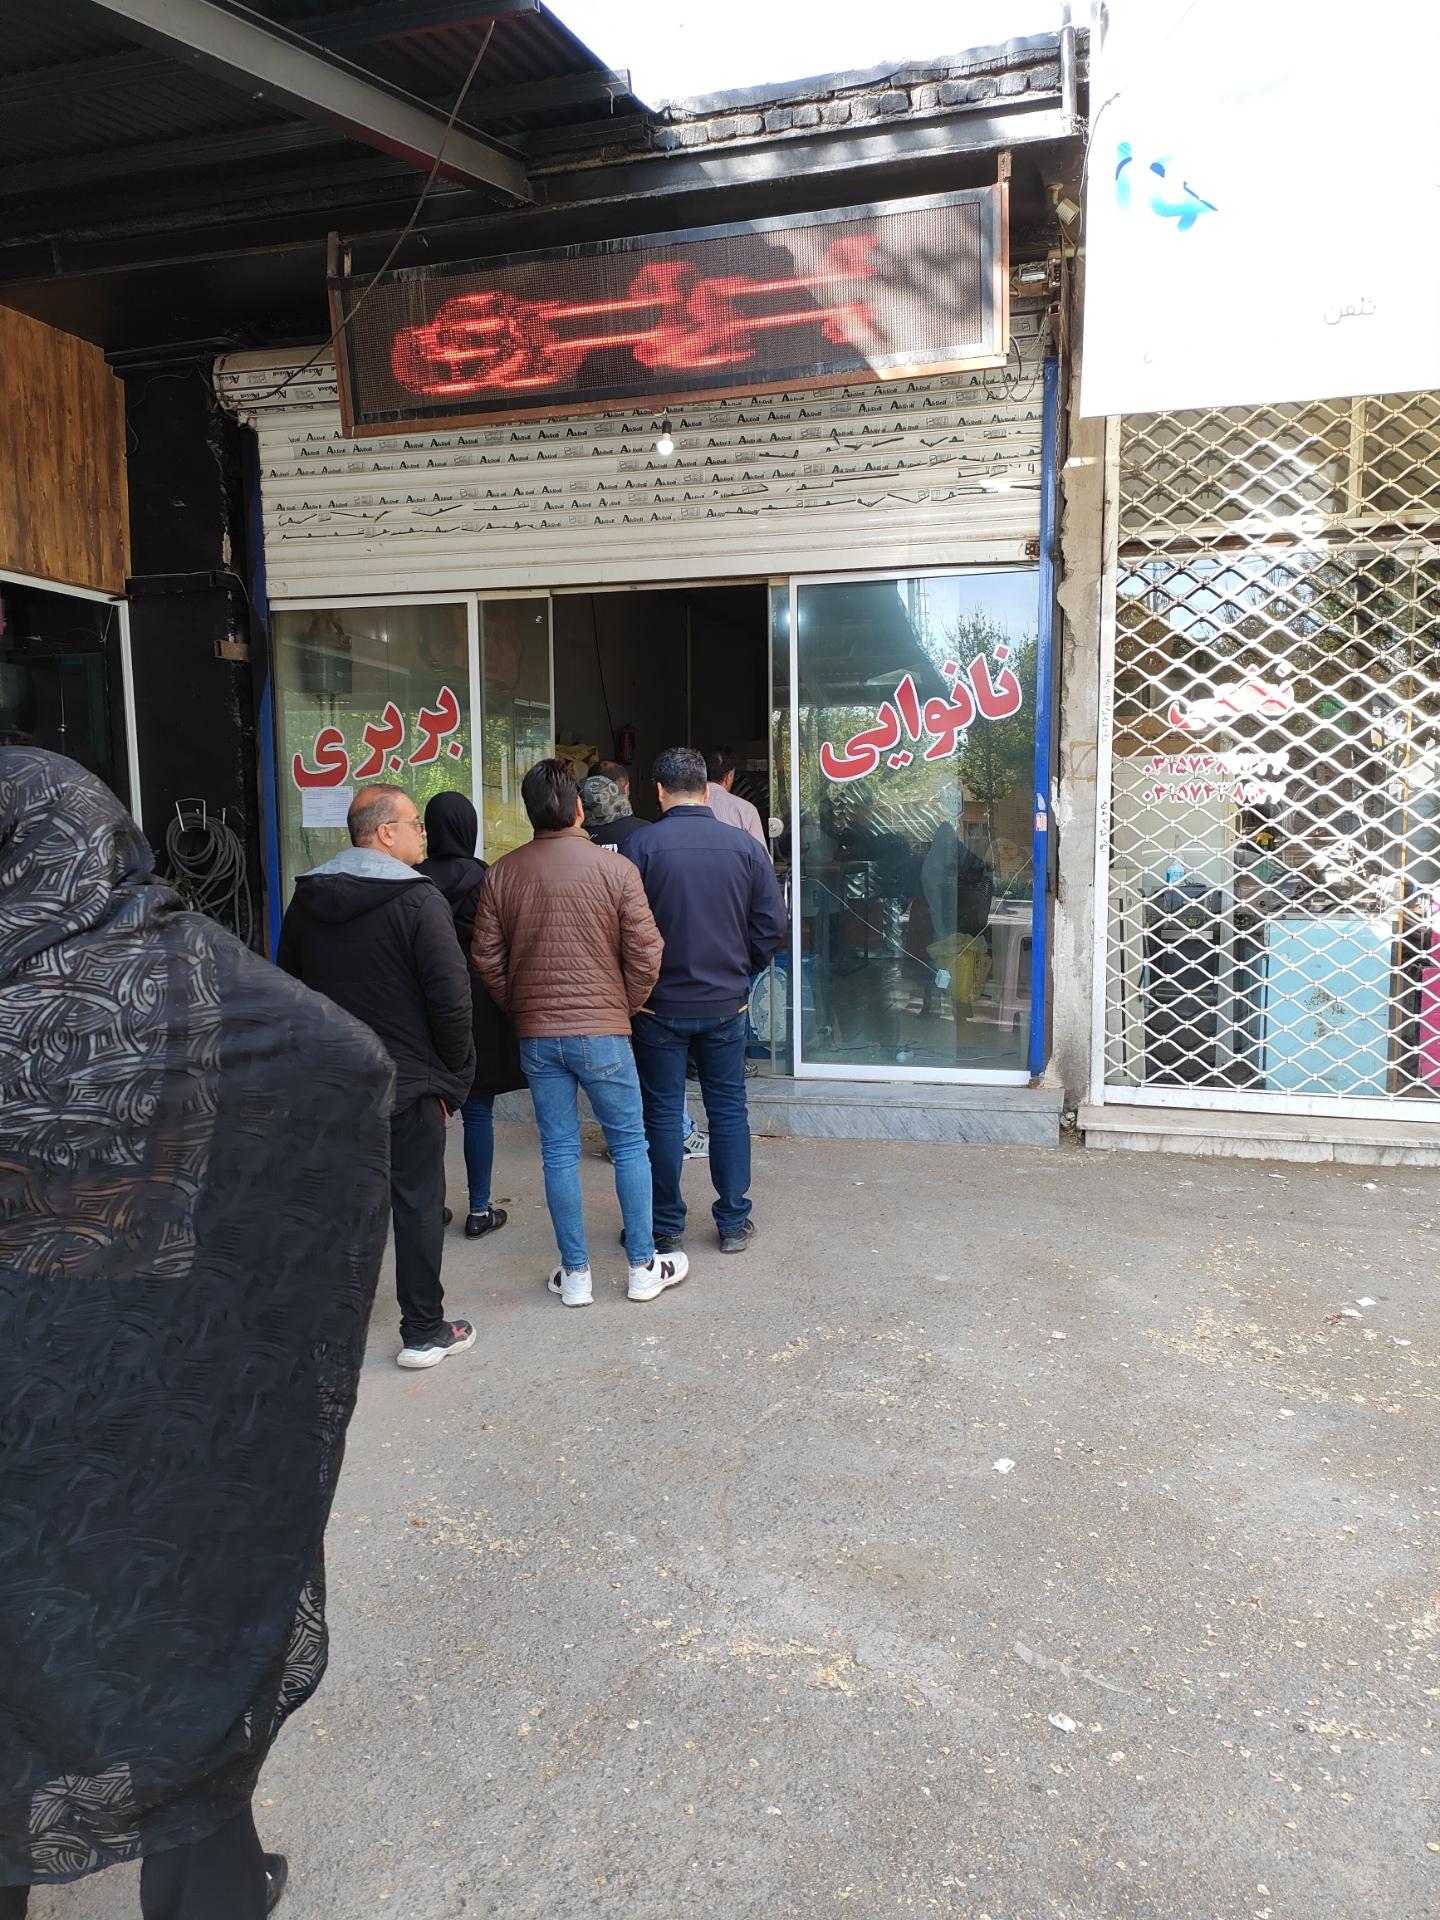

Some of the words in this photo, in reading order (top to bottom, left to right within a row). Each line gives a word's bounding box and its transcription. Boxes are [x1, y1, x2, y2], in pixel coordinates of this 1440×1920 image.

[292, 686, 463, 789] بربری
[820, 646, 1022, 781] نانوایی
[660, 1260, 676, 1280] N
